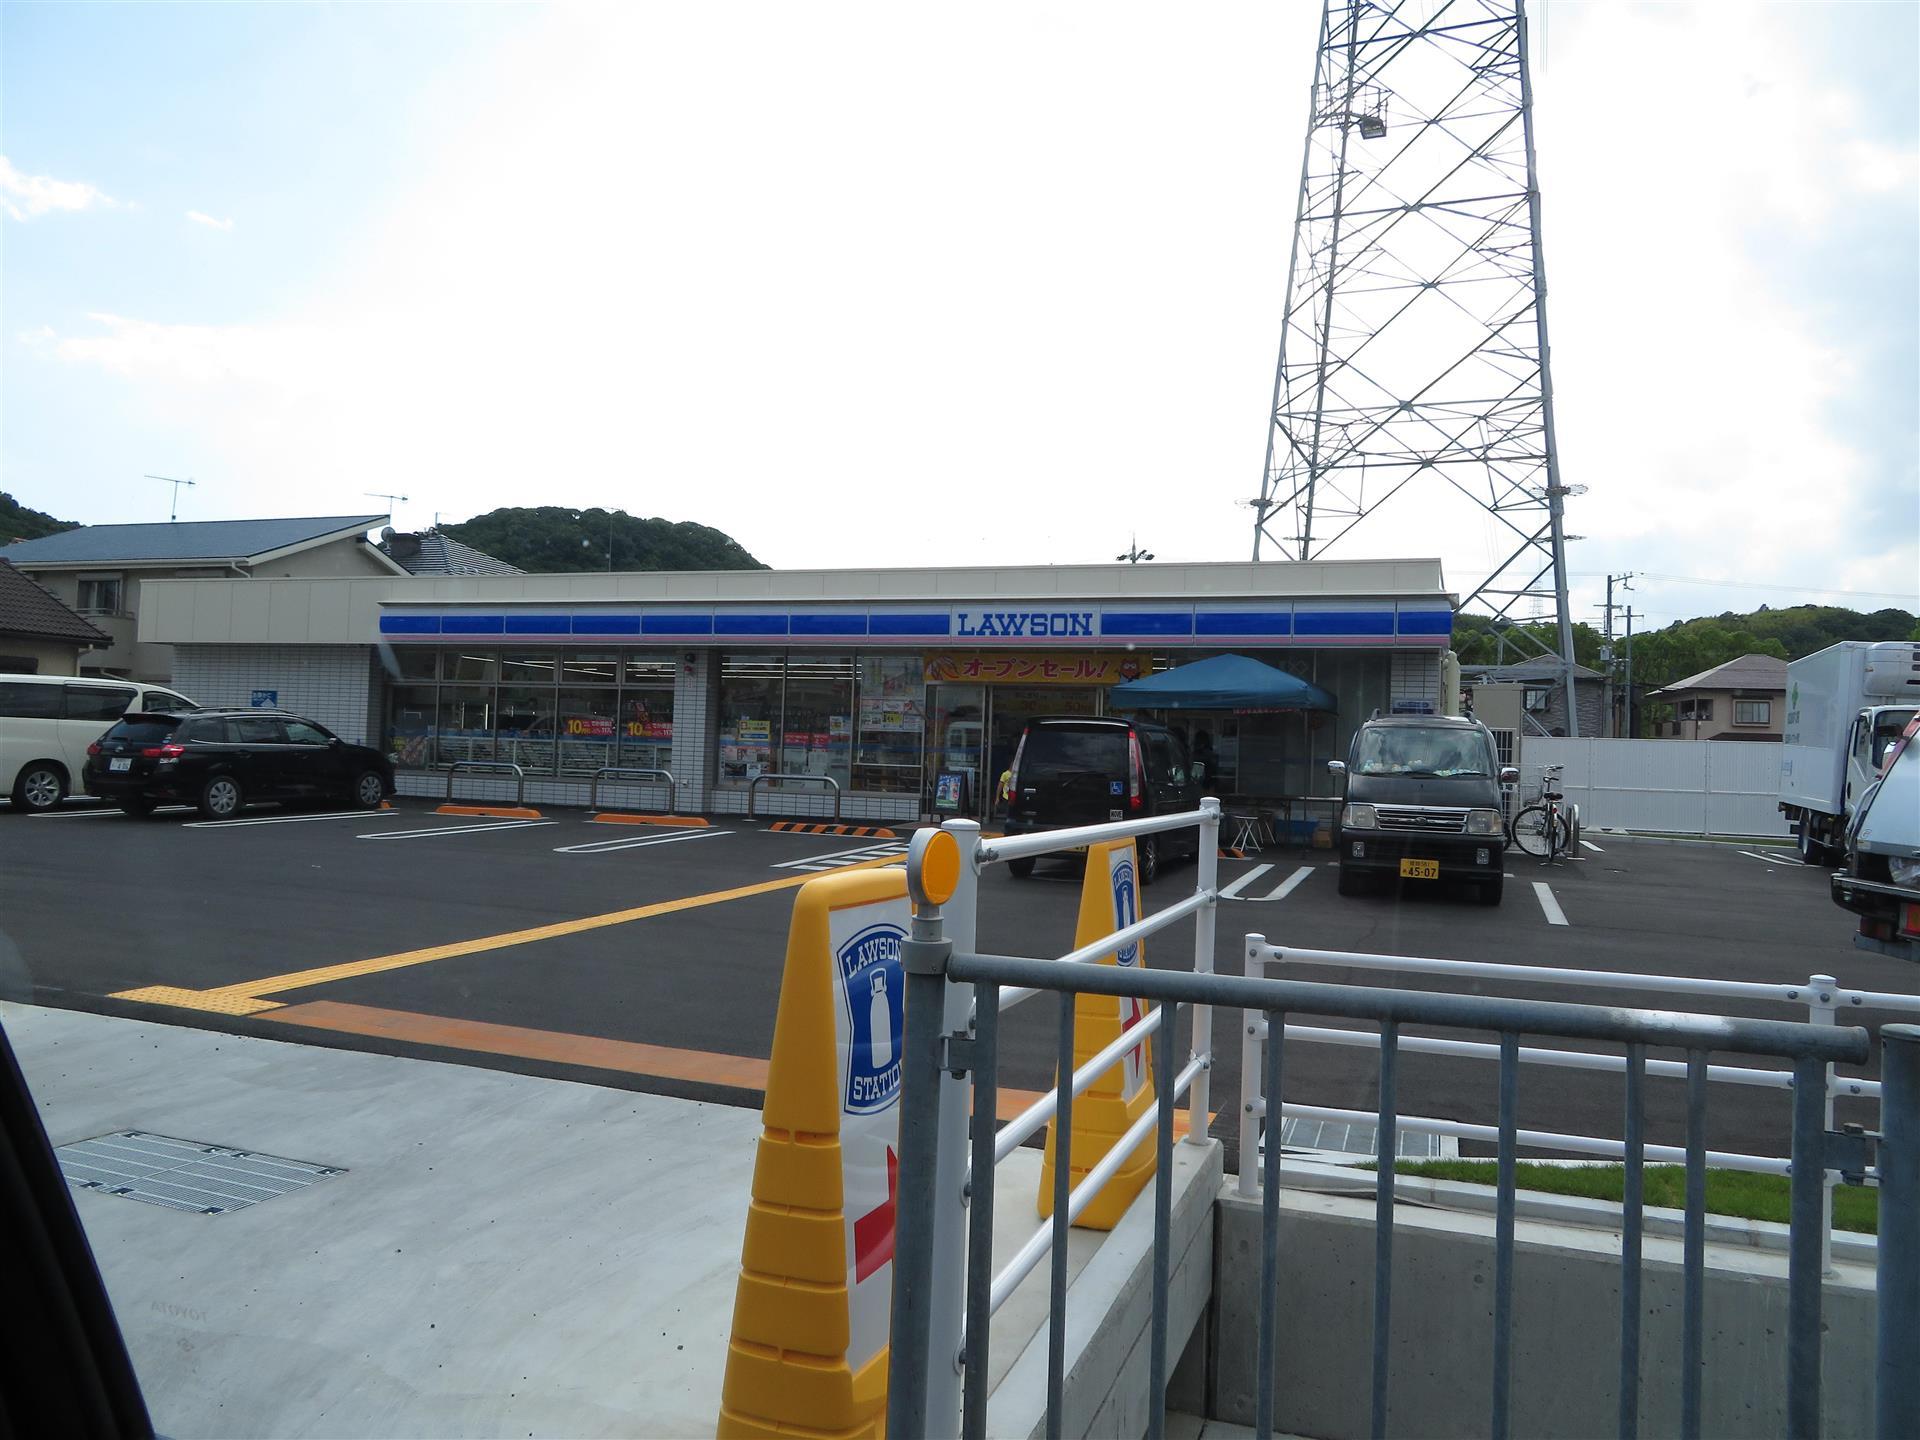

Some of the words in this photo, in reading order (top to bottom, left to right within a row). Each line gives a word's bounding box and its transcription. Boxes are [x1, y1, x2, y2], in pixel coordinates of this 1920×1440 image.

[958, 613, 1093, 636] LAWSON
[847, 938, 902, 978] LAWSON
[854, 1061, 902, 1100] STATIO
